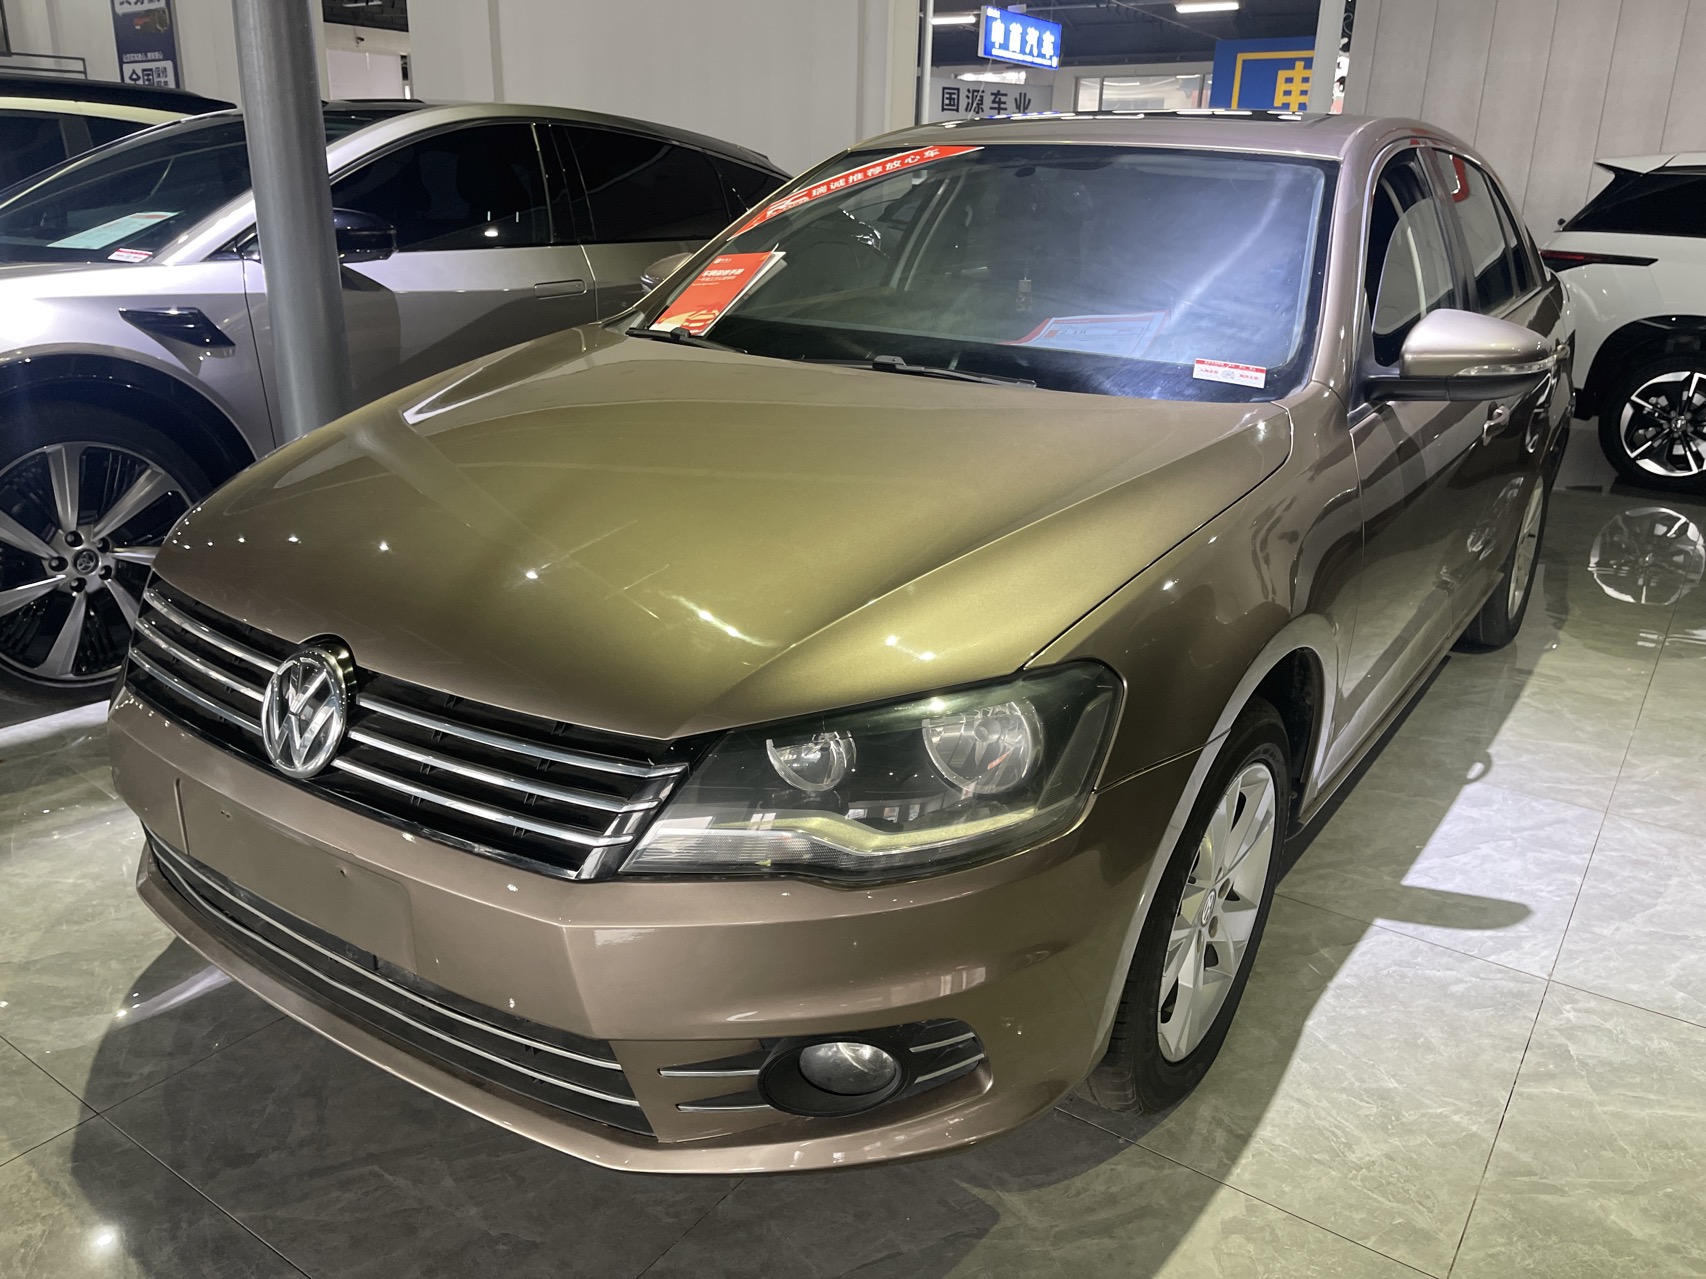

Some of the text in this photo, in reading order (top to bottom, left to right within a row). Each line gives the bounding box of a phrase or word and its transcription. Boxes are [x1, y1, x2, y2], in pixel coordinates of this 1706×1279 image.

[941, 86, 1031, 115] 国源车业
[811, 148, 941, 196] 瑞诚推荐放心车
